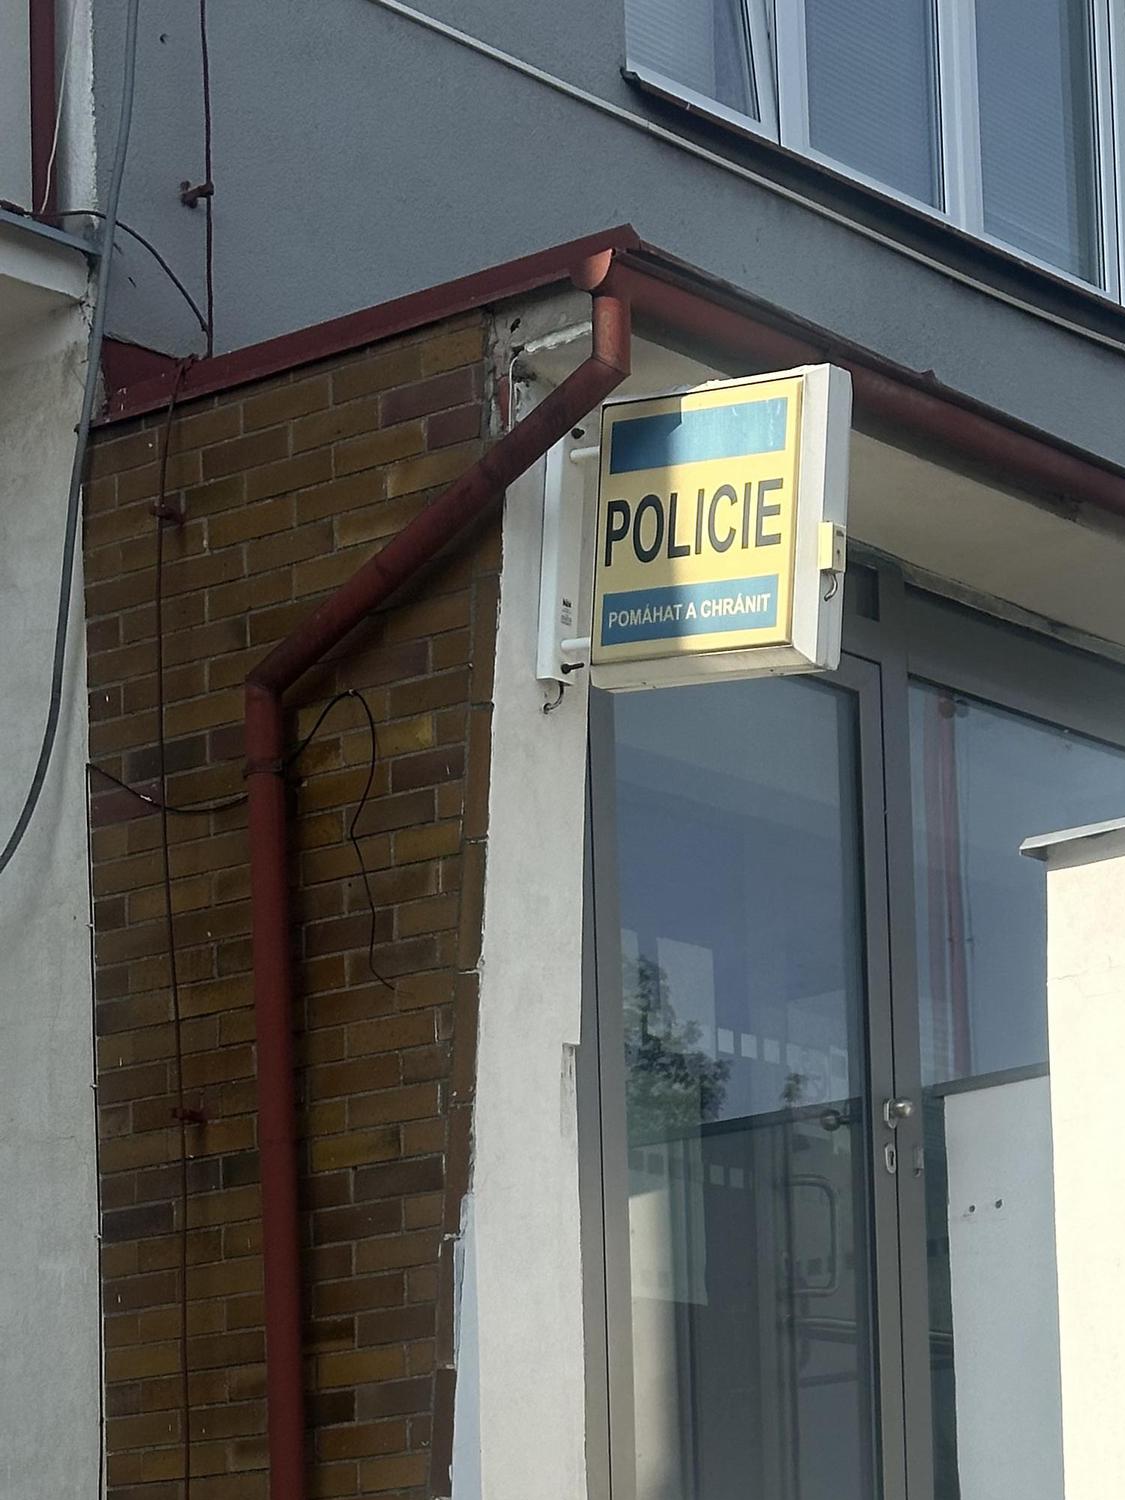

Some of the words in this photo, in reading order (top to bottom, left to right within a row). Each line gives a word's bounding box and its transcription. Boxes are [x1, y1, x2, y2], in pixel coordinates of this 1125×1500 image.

[604, 477, 783, 567] POLICIE
[608, 602, 683, 629] POMÁHAT
[685, 602, 697, 620] A
[700, 593, 771, 619] CHRÁNIT
